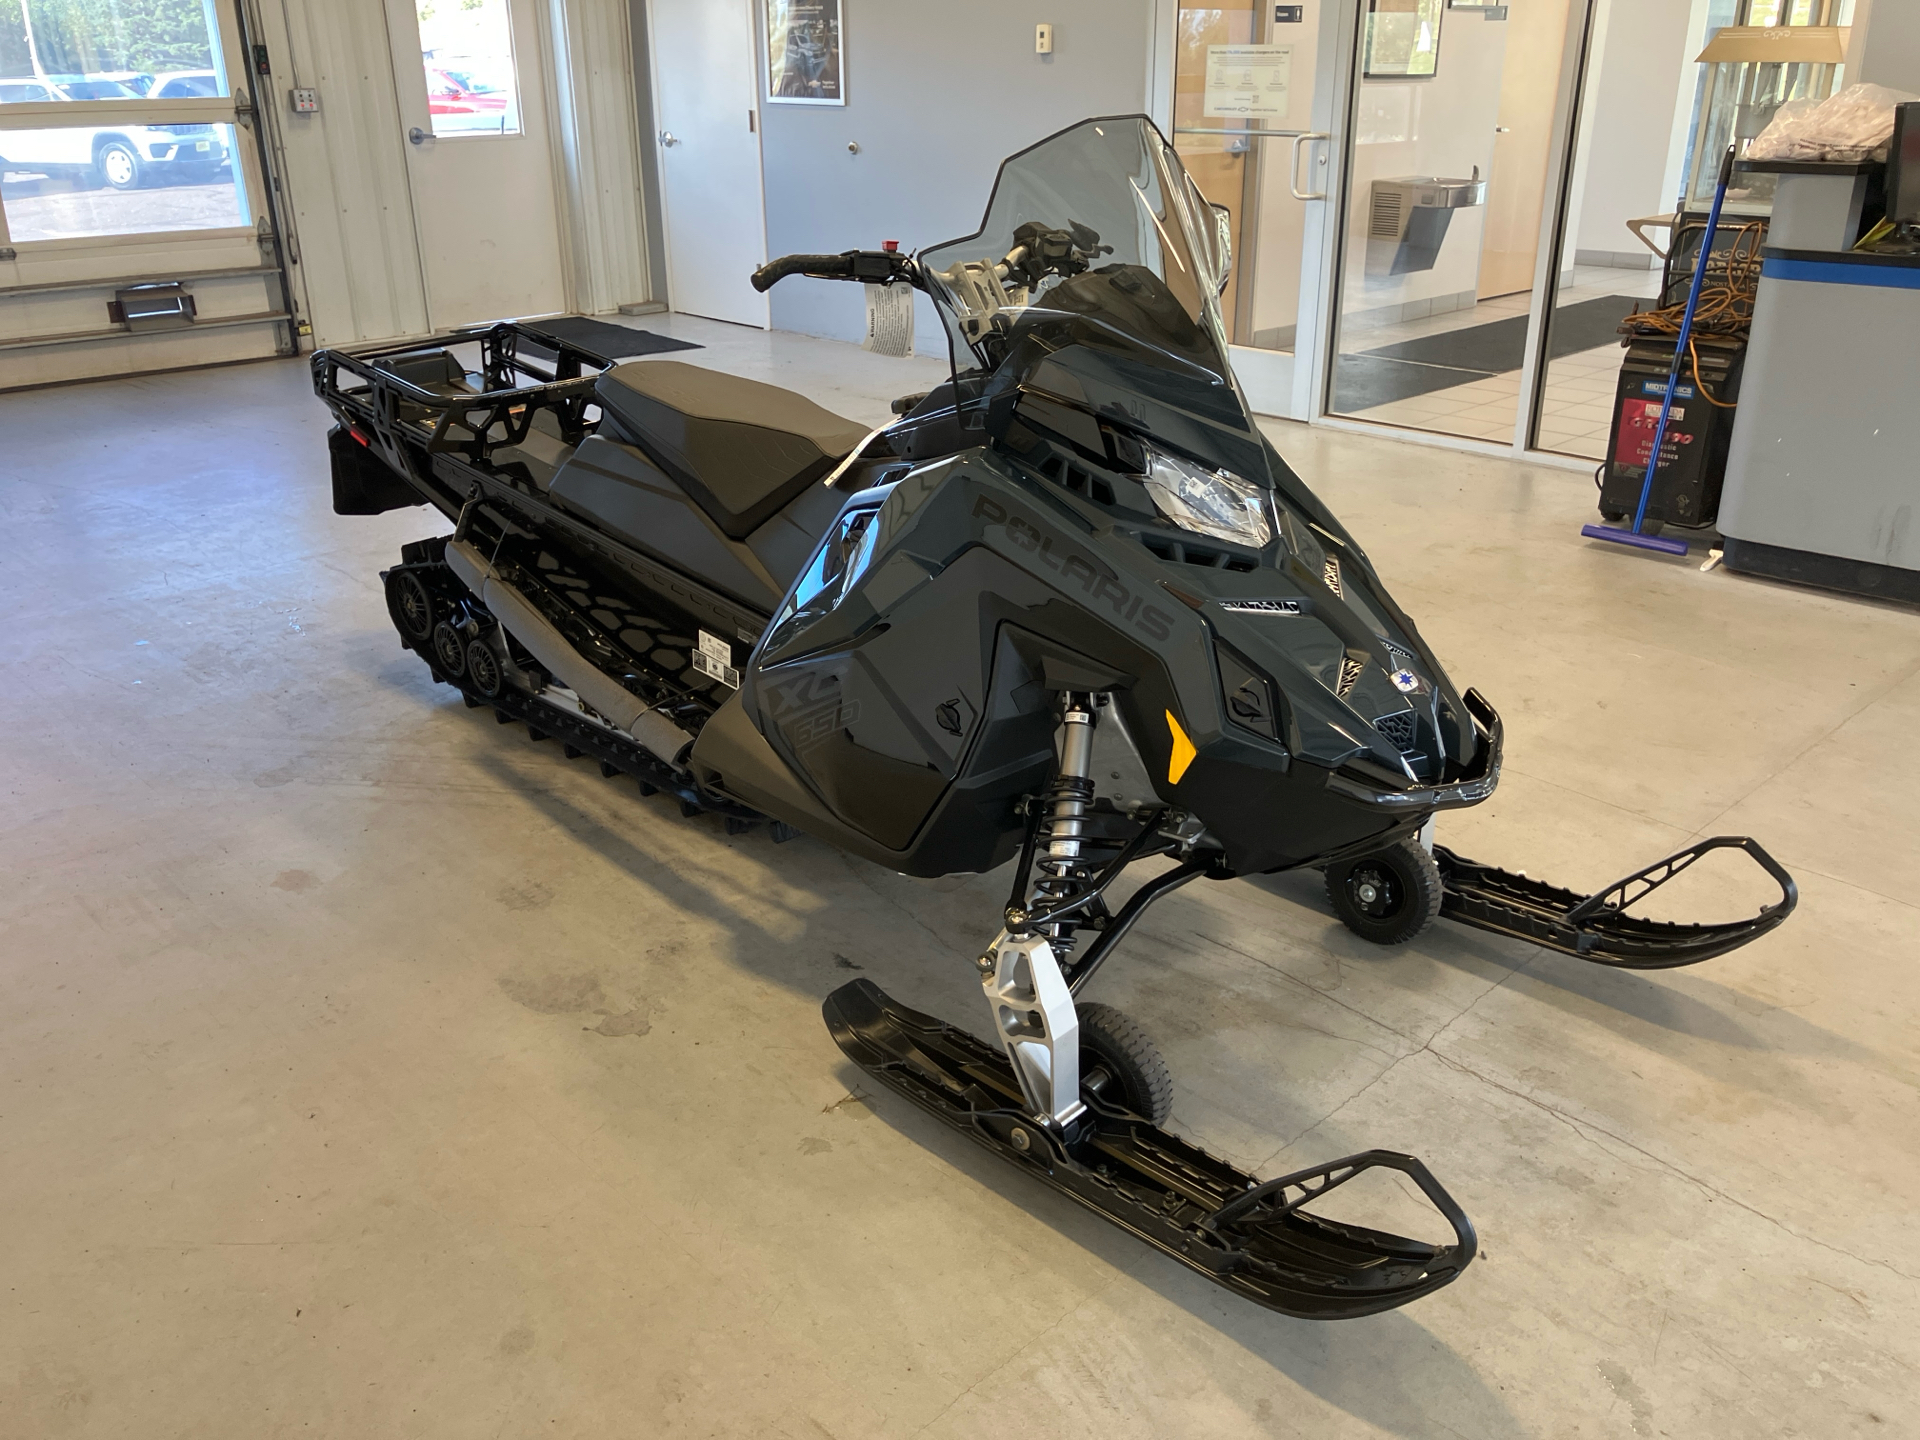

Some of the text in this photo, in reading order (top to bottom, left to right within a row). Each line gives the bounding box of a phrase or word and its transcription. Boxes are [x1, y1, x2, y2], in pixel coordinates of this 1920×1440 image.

[1645, 382, 1692, 394] MIDTRNICS
[1641, 440, 1677, 451] Diaostic
[1637, 448, 1679, 460] Condtance
[1642, 458, 1670, 468] Chger
[971, 493, 1176, 642] POLARIS
